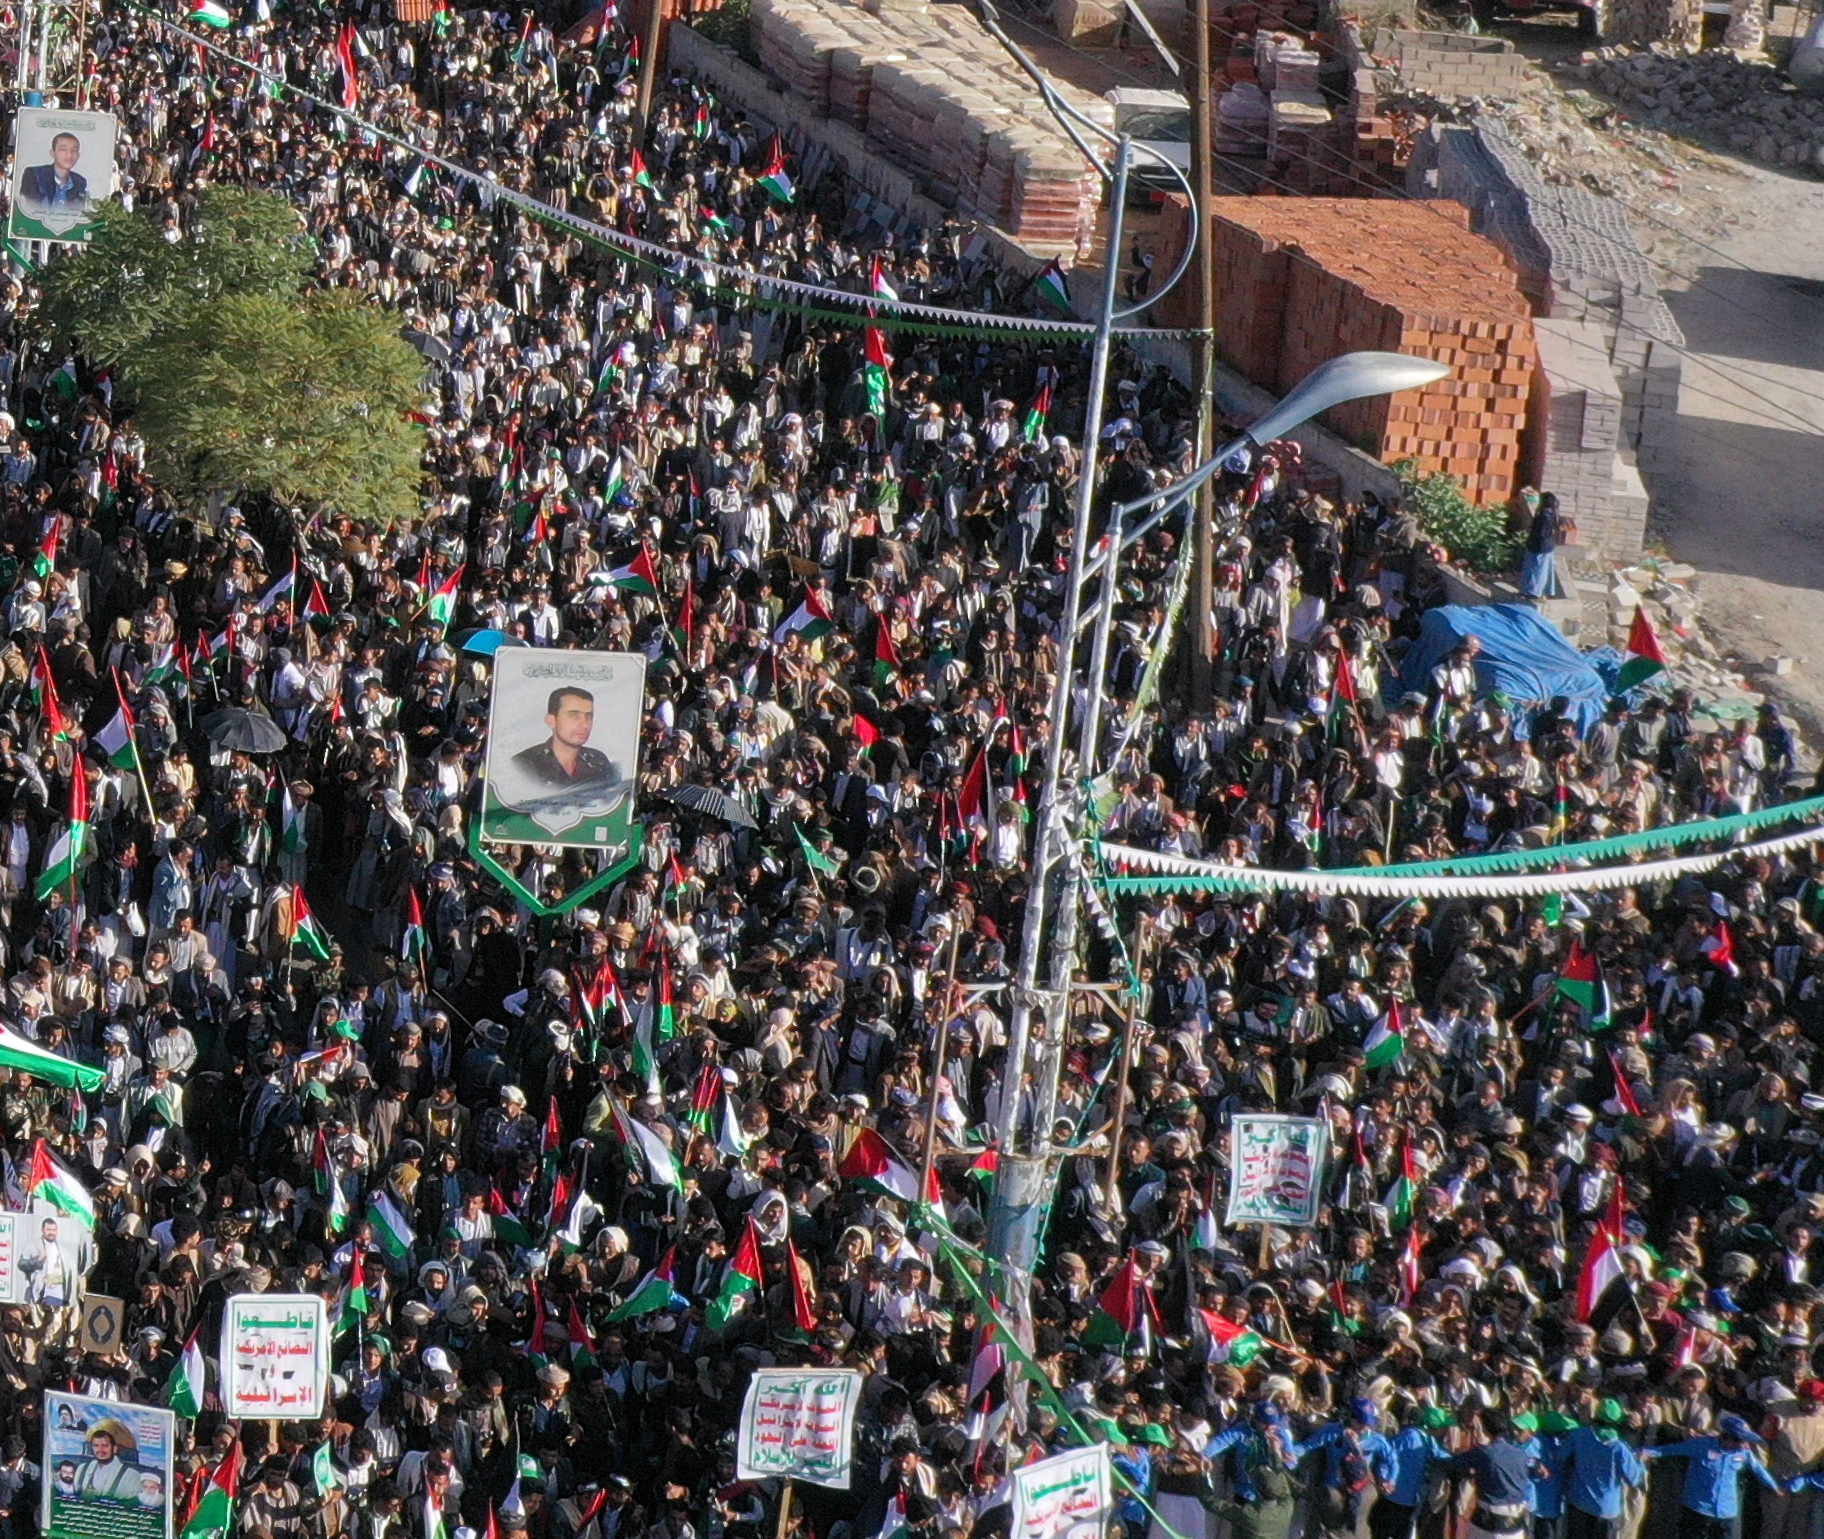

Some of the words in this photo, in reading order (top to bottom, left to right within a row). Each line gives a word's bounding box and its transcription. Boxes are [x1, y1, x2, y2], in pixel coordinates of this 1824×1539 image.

[236, 1310, 315, 1333] قاطعوا
[236, 1338, 276, 1357] الأمريكية
[277, 1339, 312, 1359] البضائع
[236, 1385, 312, 1407] الإسرائيلية
[1025, 1464, 1095, 1507] قاطعوا
